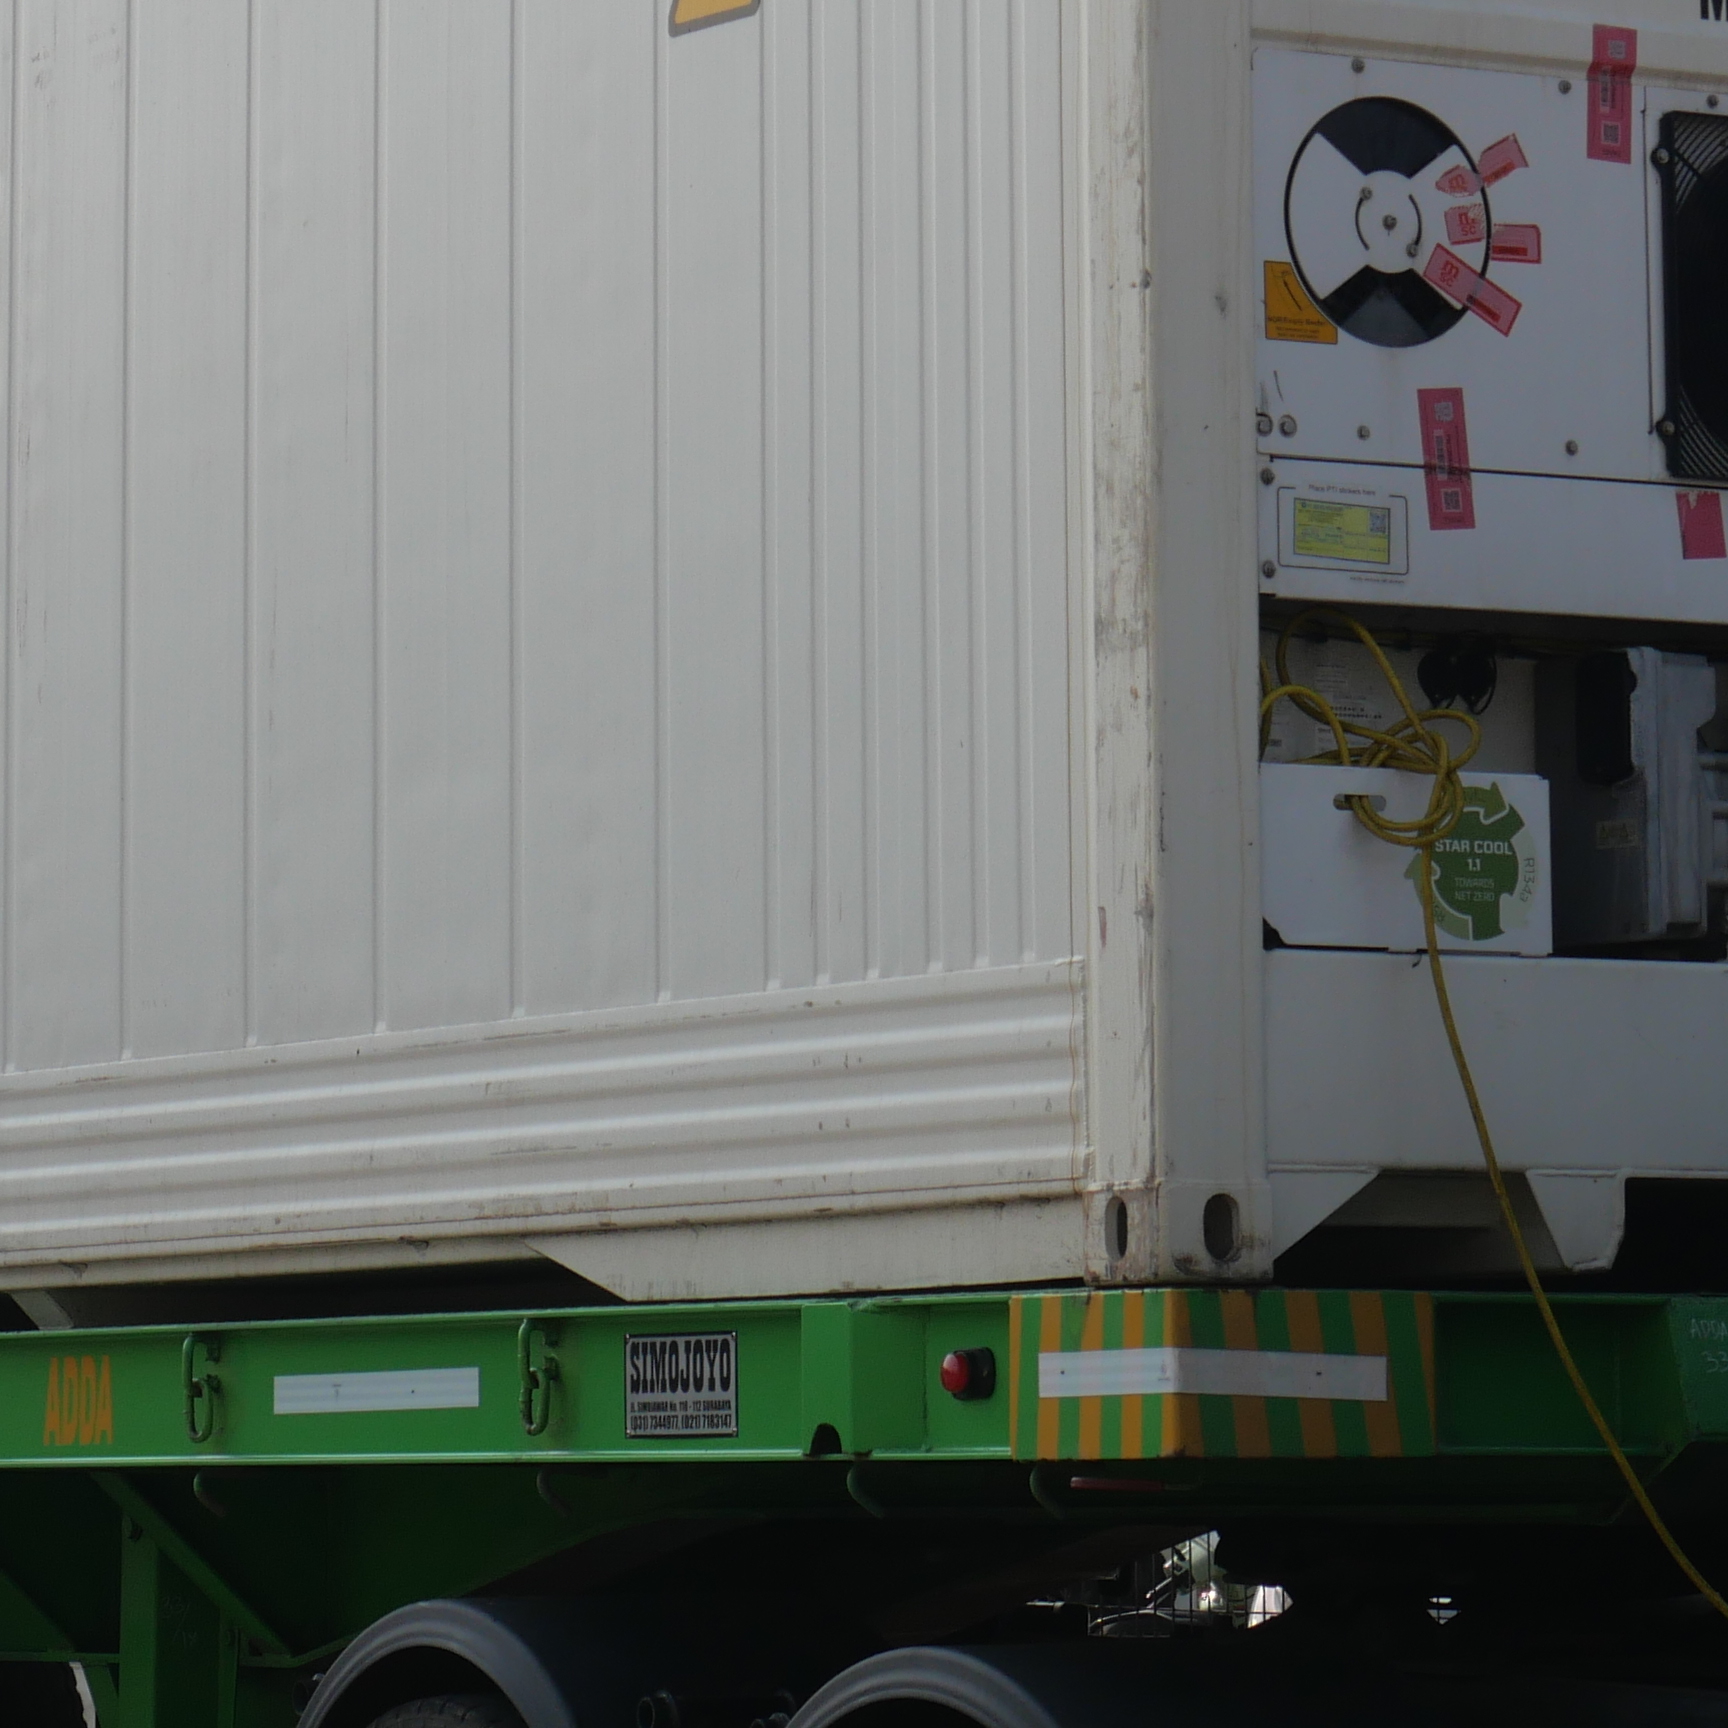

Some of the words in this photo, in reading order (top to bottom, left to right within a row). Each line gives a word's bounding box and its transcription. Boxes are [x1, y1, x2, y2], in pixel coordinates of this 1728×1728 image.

[1434, 839, 1470, 854] STAR
[1473, 840, 1513, 855] COOL
[630, 1338, 731, 1395] SIMOJOYO
[43, 1354, 114, 1446] ADDA
